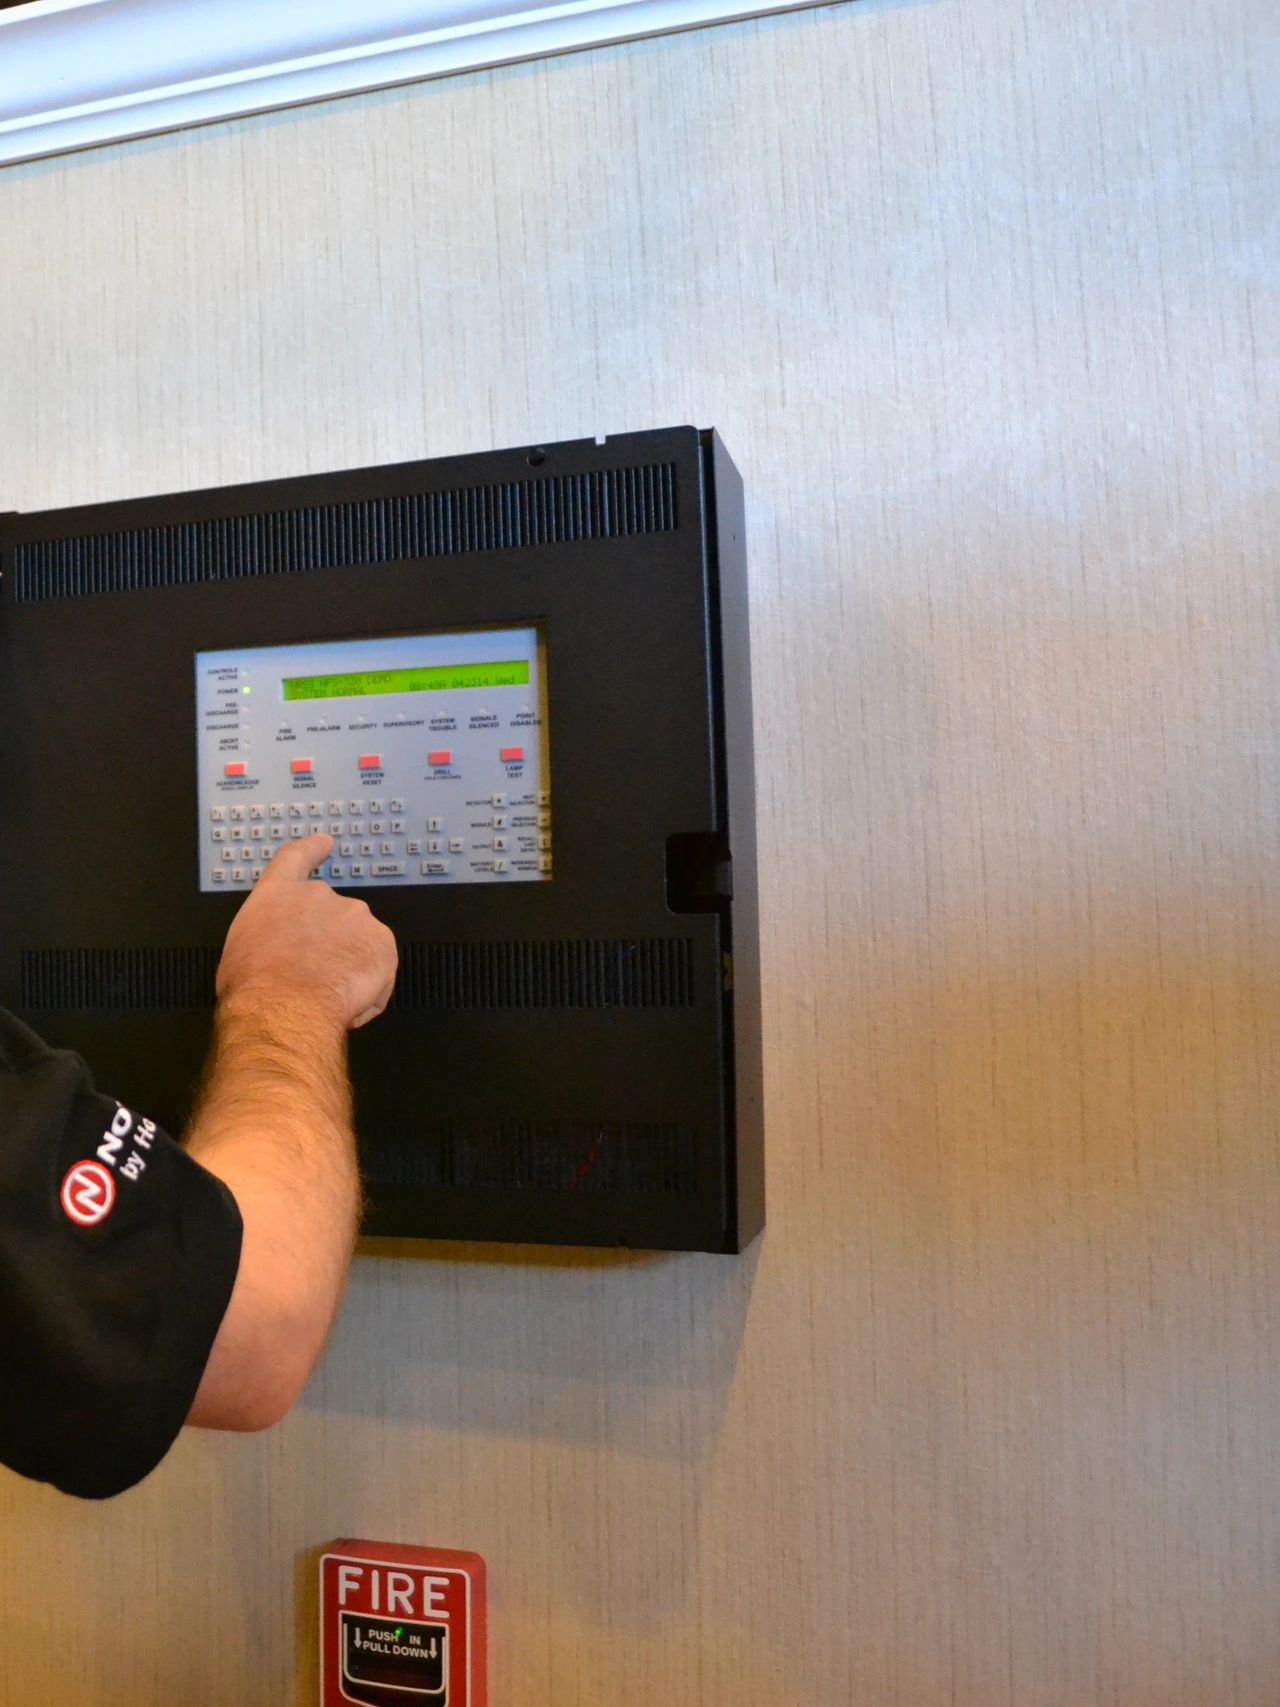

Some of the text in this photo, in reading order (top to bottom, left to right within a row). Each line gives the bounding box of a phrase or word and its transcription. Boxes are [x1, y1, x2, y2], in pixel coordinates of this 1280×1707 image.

[495, 674, 516, 685] Wed
[383, 720, 424, 728] SUPERVISORY
[510, 719, 542, 727] DISABLED
[120, 1150, 147, 1181] by
[338, 1565, 450, 1619] FIRE
[368, 1629, 421, 1645] PUSH IN
[363, 1641, 429, 1658] PULL DOWN
